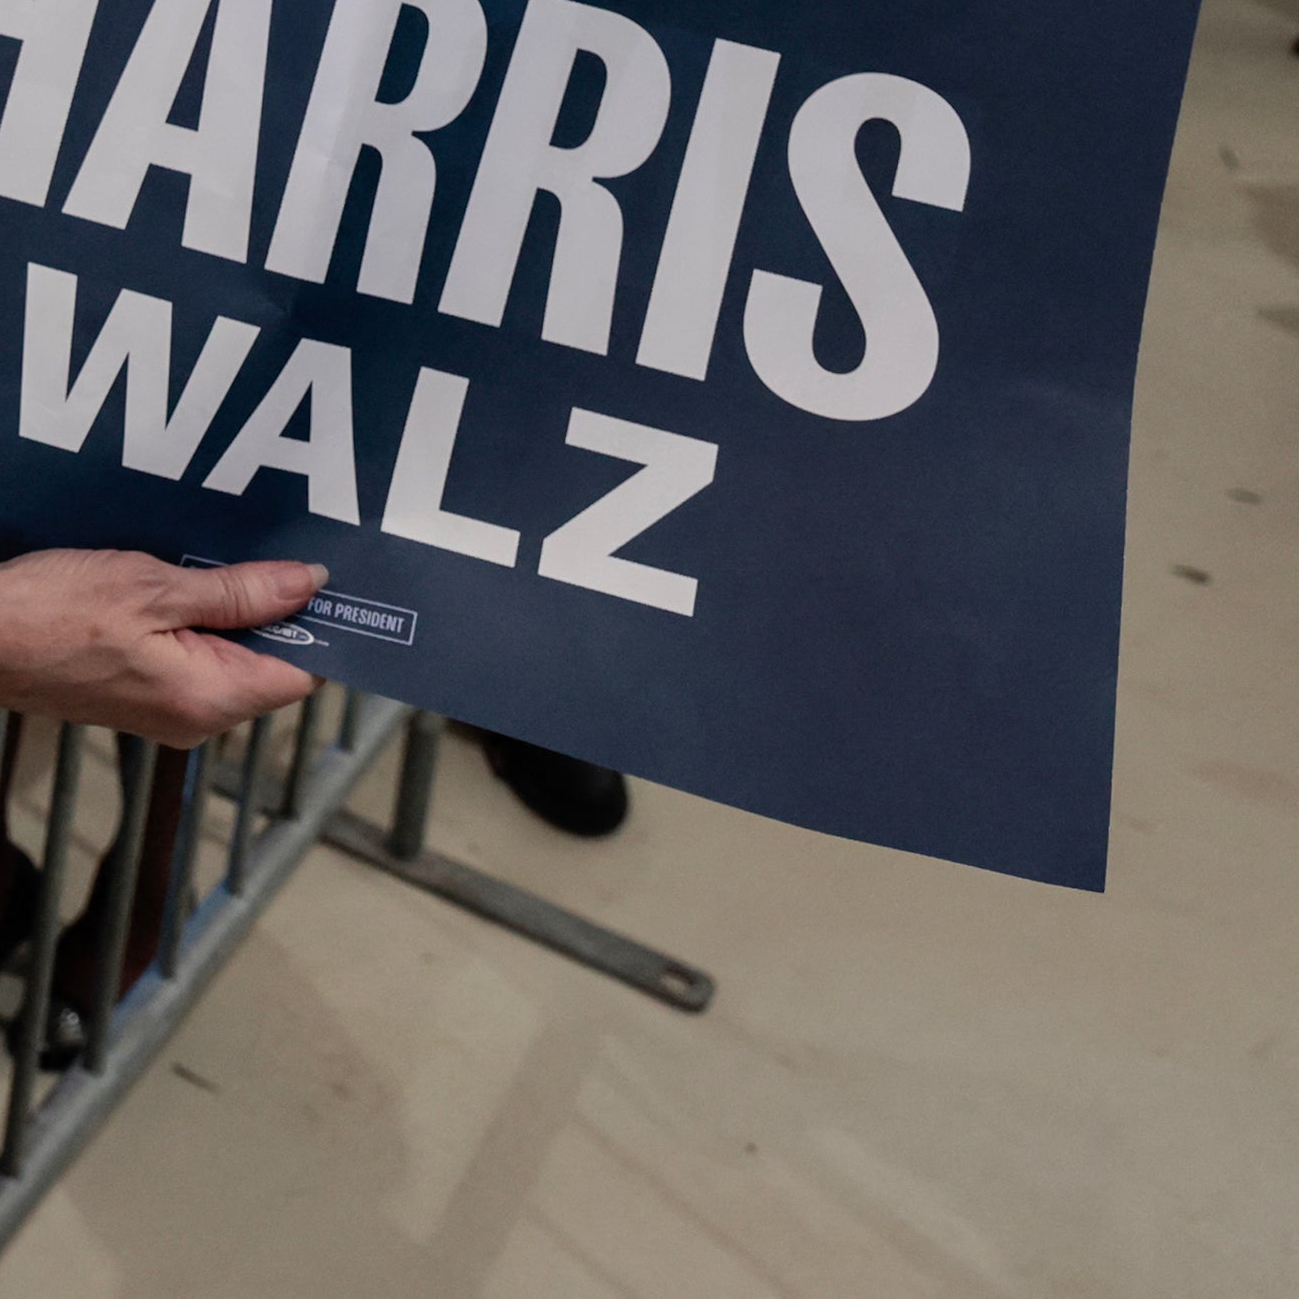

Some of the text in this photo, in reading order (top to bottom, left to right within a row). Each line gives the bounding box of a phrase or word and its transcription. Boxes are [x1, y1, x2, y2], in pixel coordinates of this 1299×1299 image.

[18, 262, 719, 617] WALZ
[307, 597, 405, 633] FOR PRESIDENT
